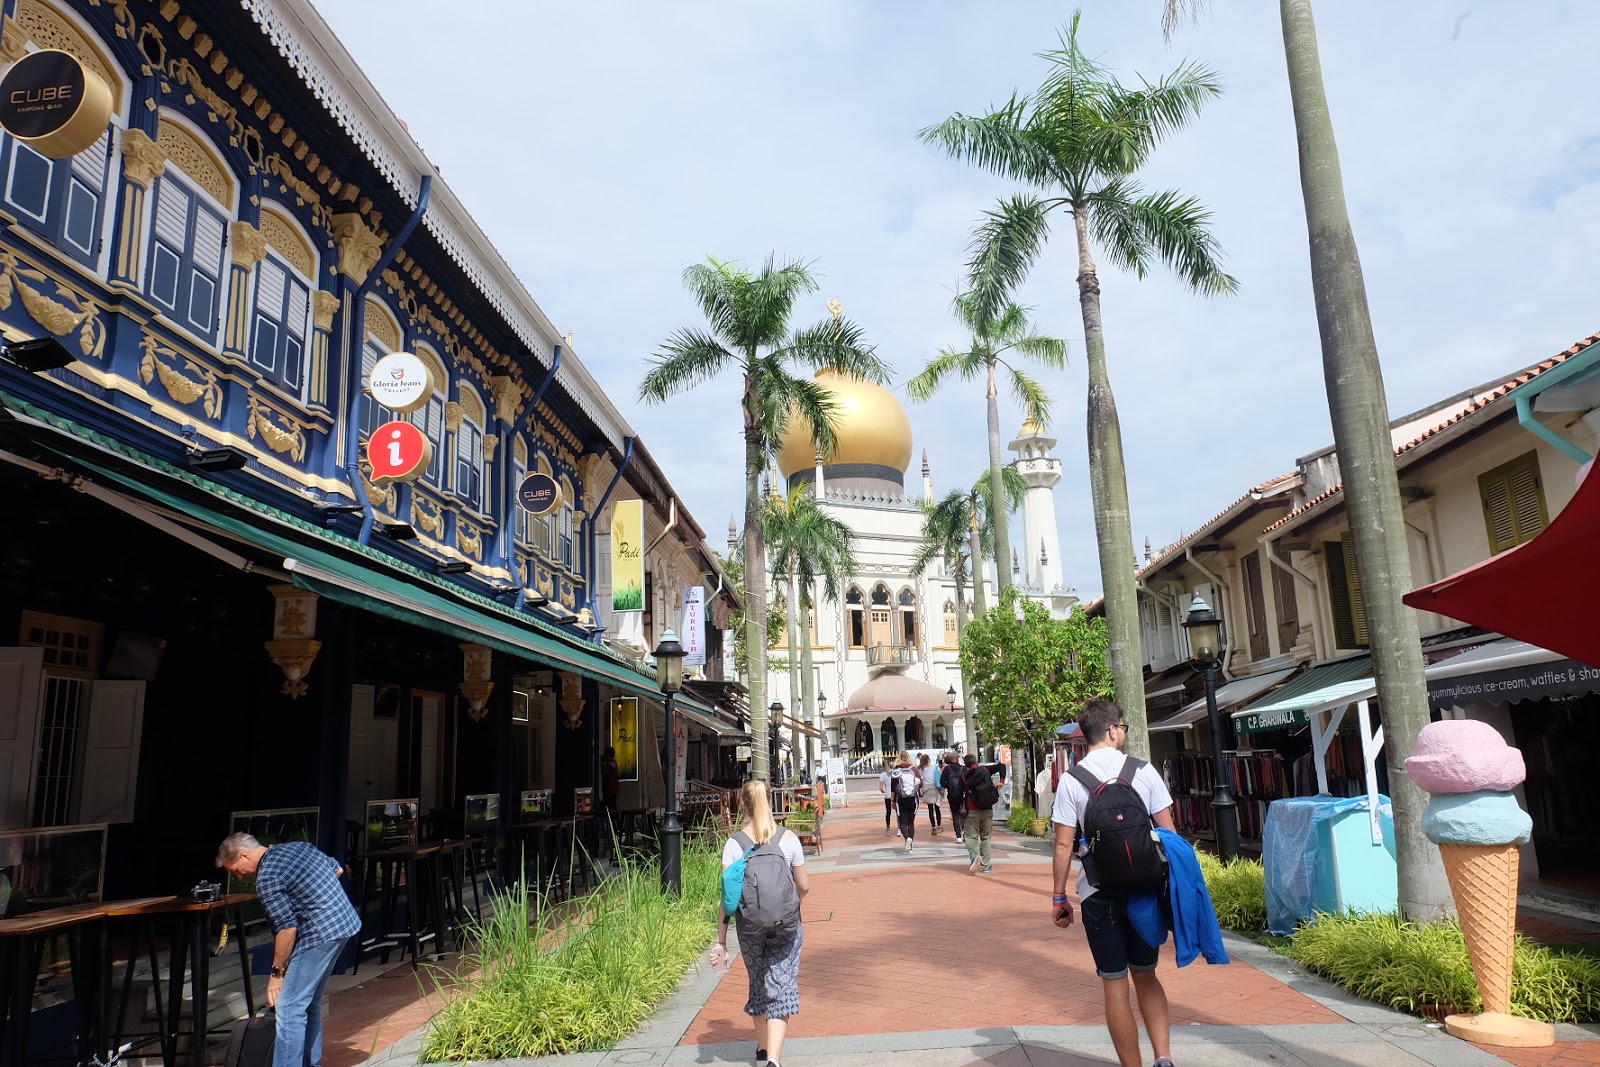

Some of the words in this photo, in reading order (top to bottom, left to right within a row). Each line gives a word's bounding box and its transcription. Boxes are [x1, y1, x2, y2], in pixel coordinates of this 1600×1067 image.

[10, 85, 72, 103] CUBE
[400, 379, 421, 387] Jean's
[524, 489, 552, 498] CUBE
[620, 541, 640, 559] Padi
[689, 605, 697, 652] TURKISH
[1430, 684, 1482, 701] yummylicious
[1482, 679, 1530, 692] ice-cream,
[1530, 671, 1566, 686] waffles
[1568, 668, 1576, 681] &
